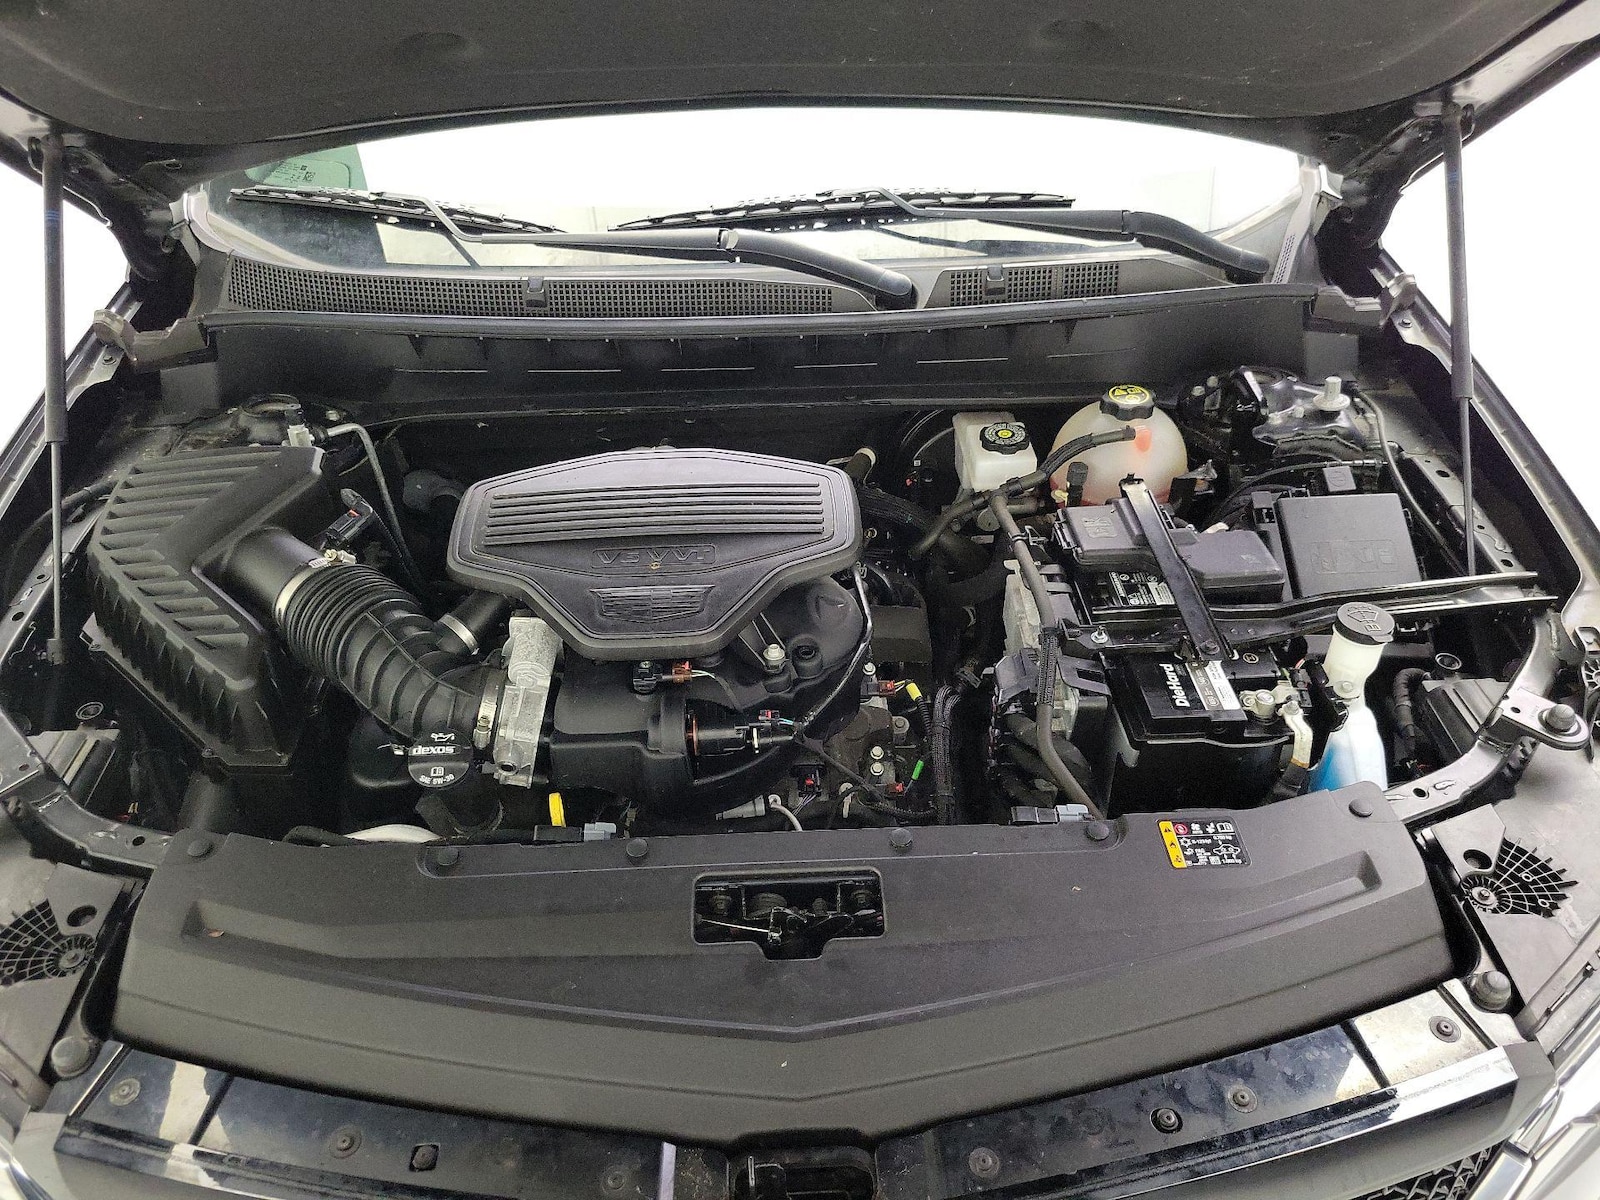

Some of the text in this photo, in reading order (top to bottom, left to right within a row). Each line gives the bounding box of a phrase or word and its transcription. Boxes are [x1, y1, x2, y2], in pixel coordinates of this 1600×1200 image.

[1159, 663, 1190, 708] DieHard
[412, 745, 456, 755] dexos
[419, 773, 455, 785] SAE 5W-30
